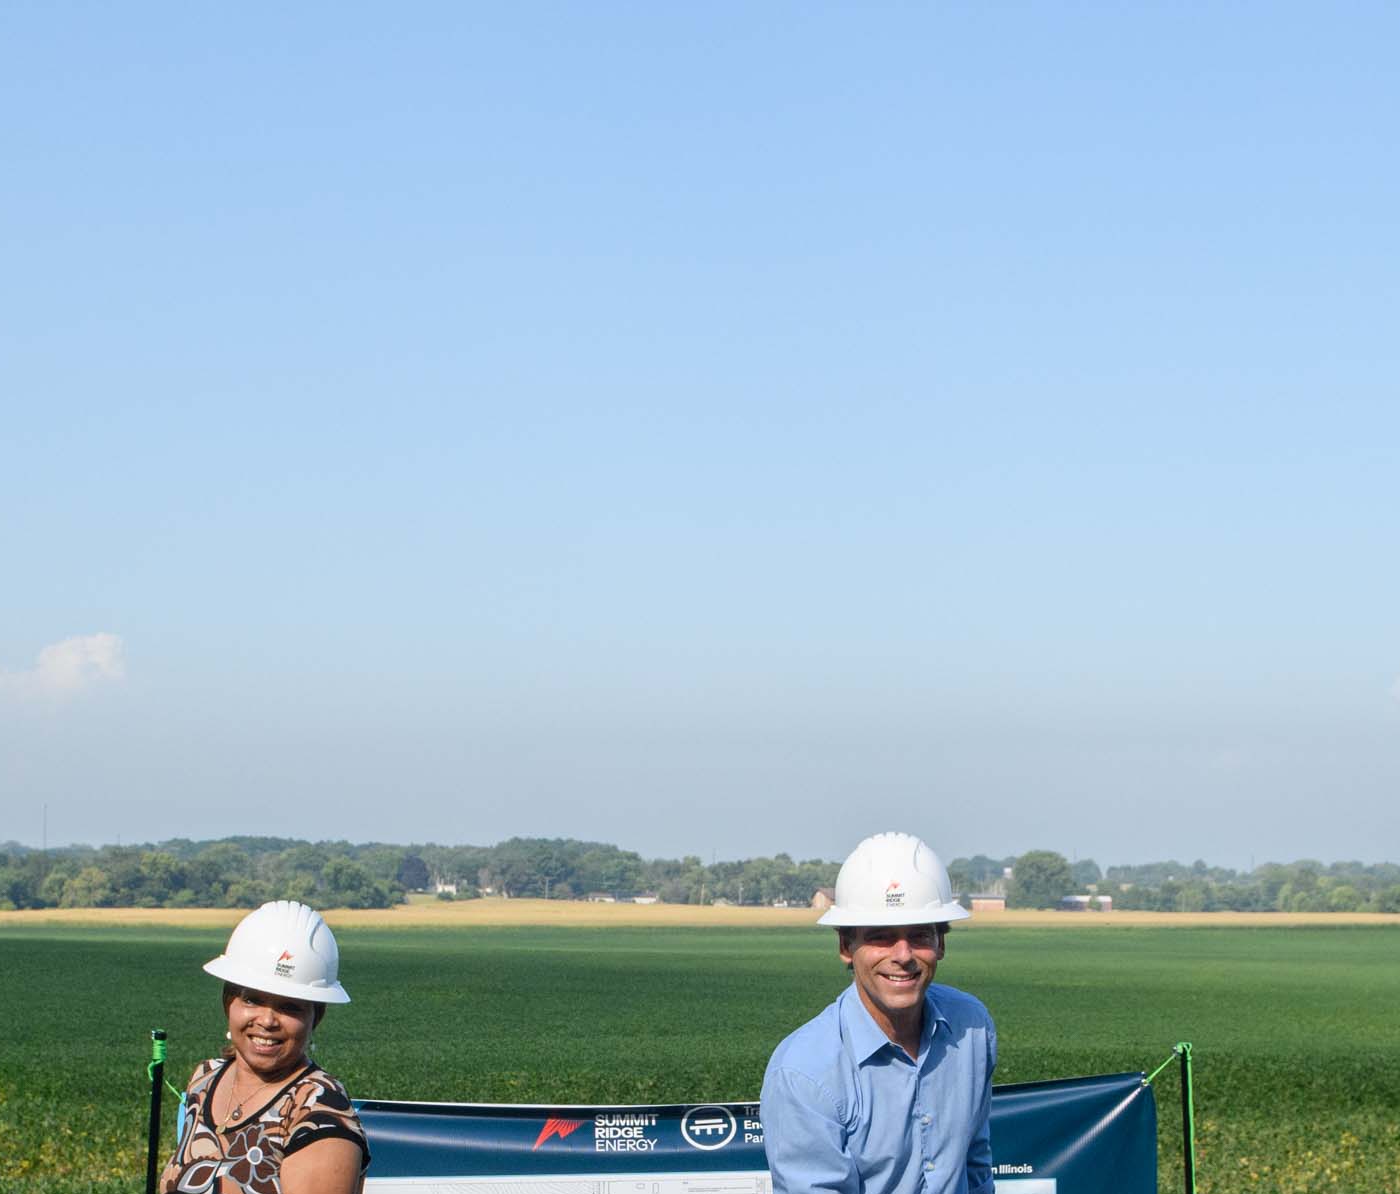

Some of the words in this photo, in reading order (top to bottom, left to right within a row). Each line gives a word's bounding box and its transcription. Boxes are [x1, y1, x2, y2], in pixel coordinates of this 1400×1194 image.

[594, 1113, 660, 1127] SUMMIT
[594, 1127, 644, 1139] RIDGE
[595, 1138, 658, 1152] ENERGY
[999, 1163, 1033, 1175] Illinois
